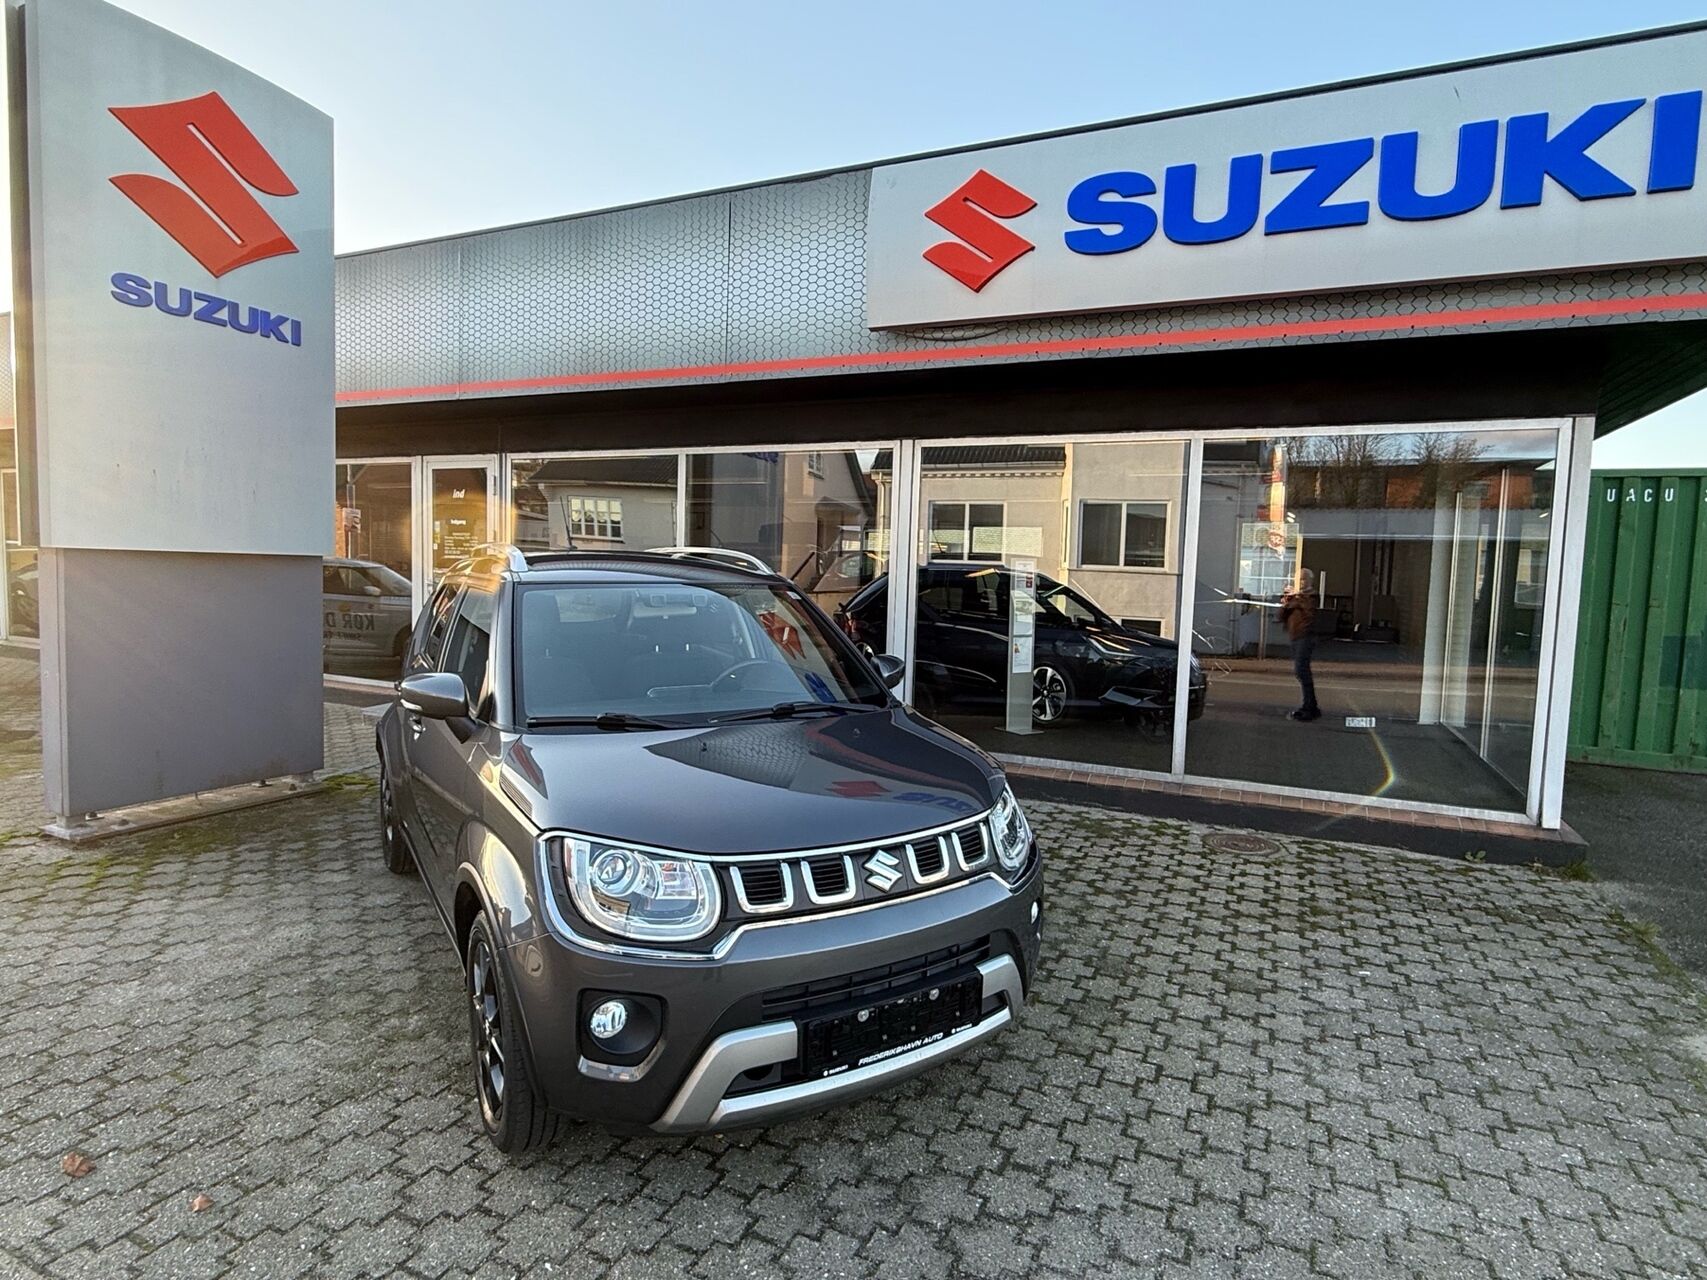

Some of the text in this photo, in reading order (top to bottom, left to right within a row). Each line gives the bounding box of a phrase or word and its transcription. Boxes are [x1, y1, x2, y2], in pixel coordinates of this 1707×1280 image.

[1065, 90, 1703, 256] SUZUKI
[110, 272, 301, 347] SUZUKI
[1606, 487, 1674, 502] UACU
[858, 1039, 922, 1066] FREDERIKSHAVN
[922, 1032, 944, 1045] AUTO
